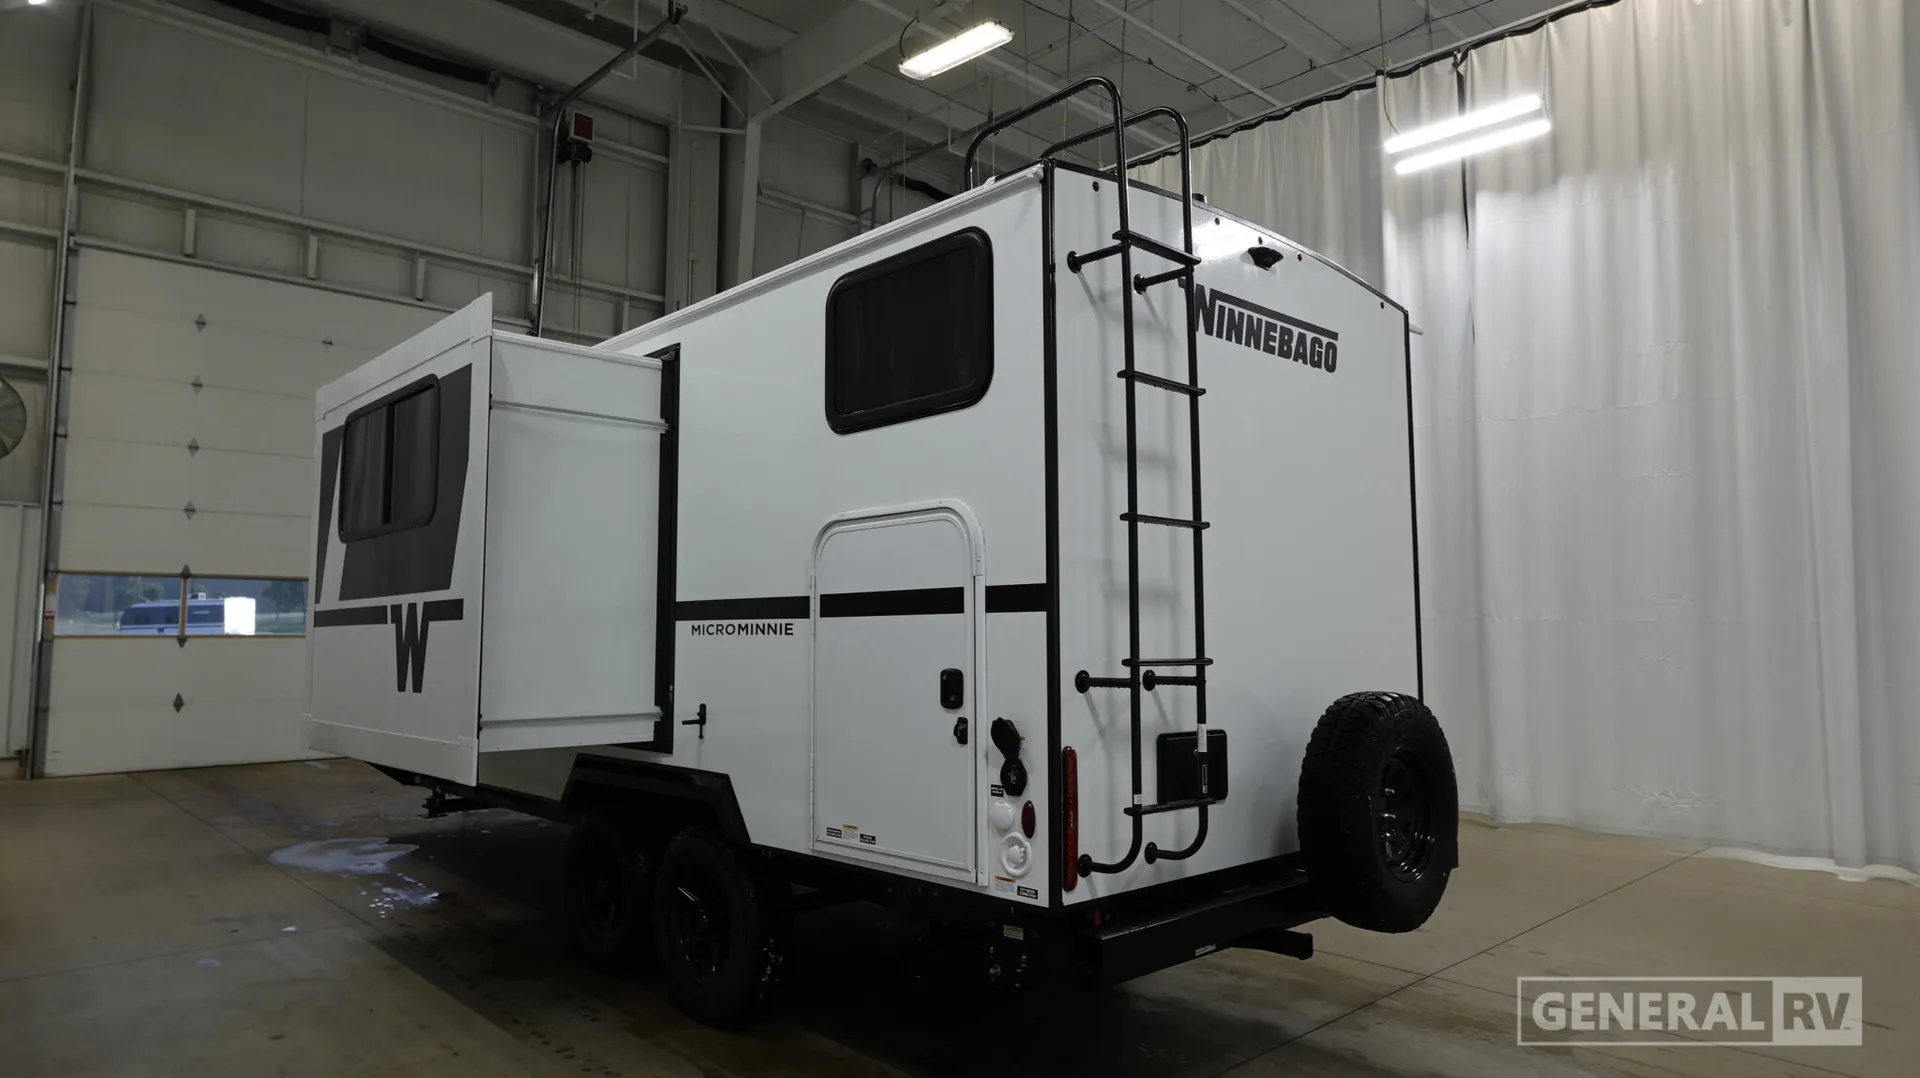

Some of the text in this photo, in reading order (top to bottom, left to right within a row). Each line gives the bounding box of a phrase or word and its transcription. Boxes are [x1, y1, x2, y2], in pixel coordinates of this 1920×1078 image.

[1178, 277, 1338, 373] WINNEBAGO
[391, 598, 463, 693] W
[691, 622, 794, 636] MICROMINNIE
